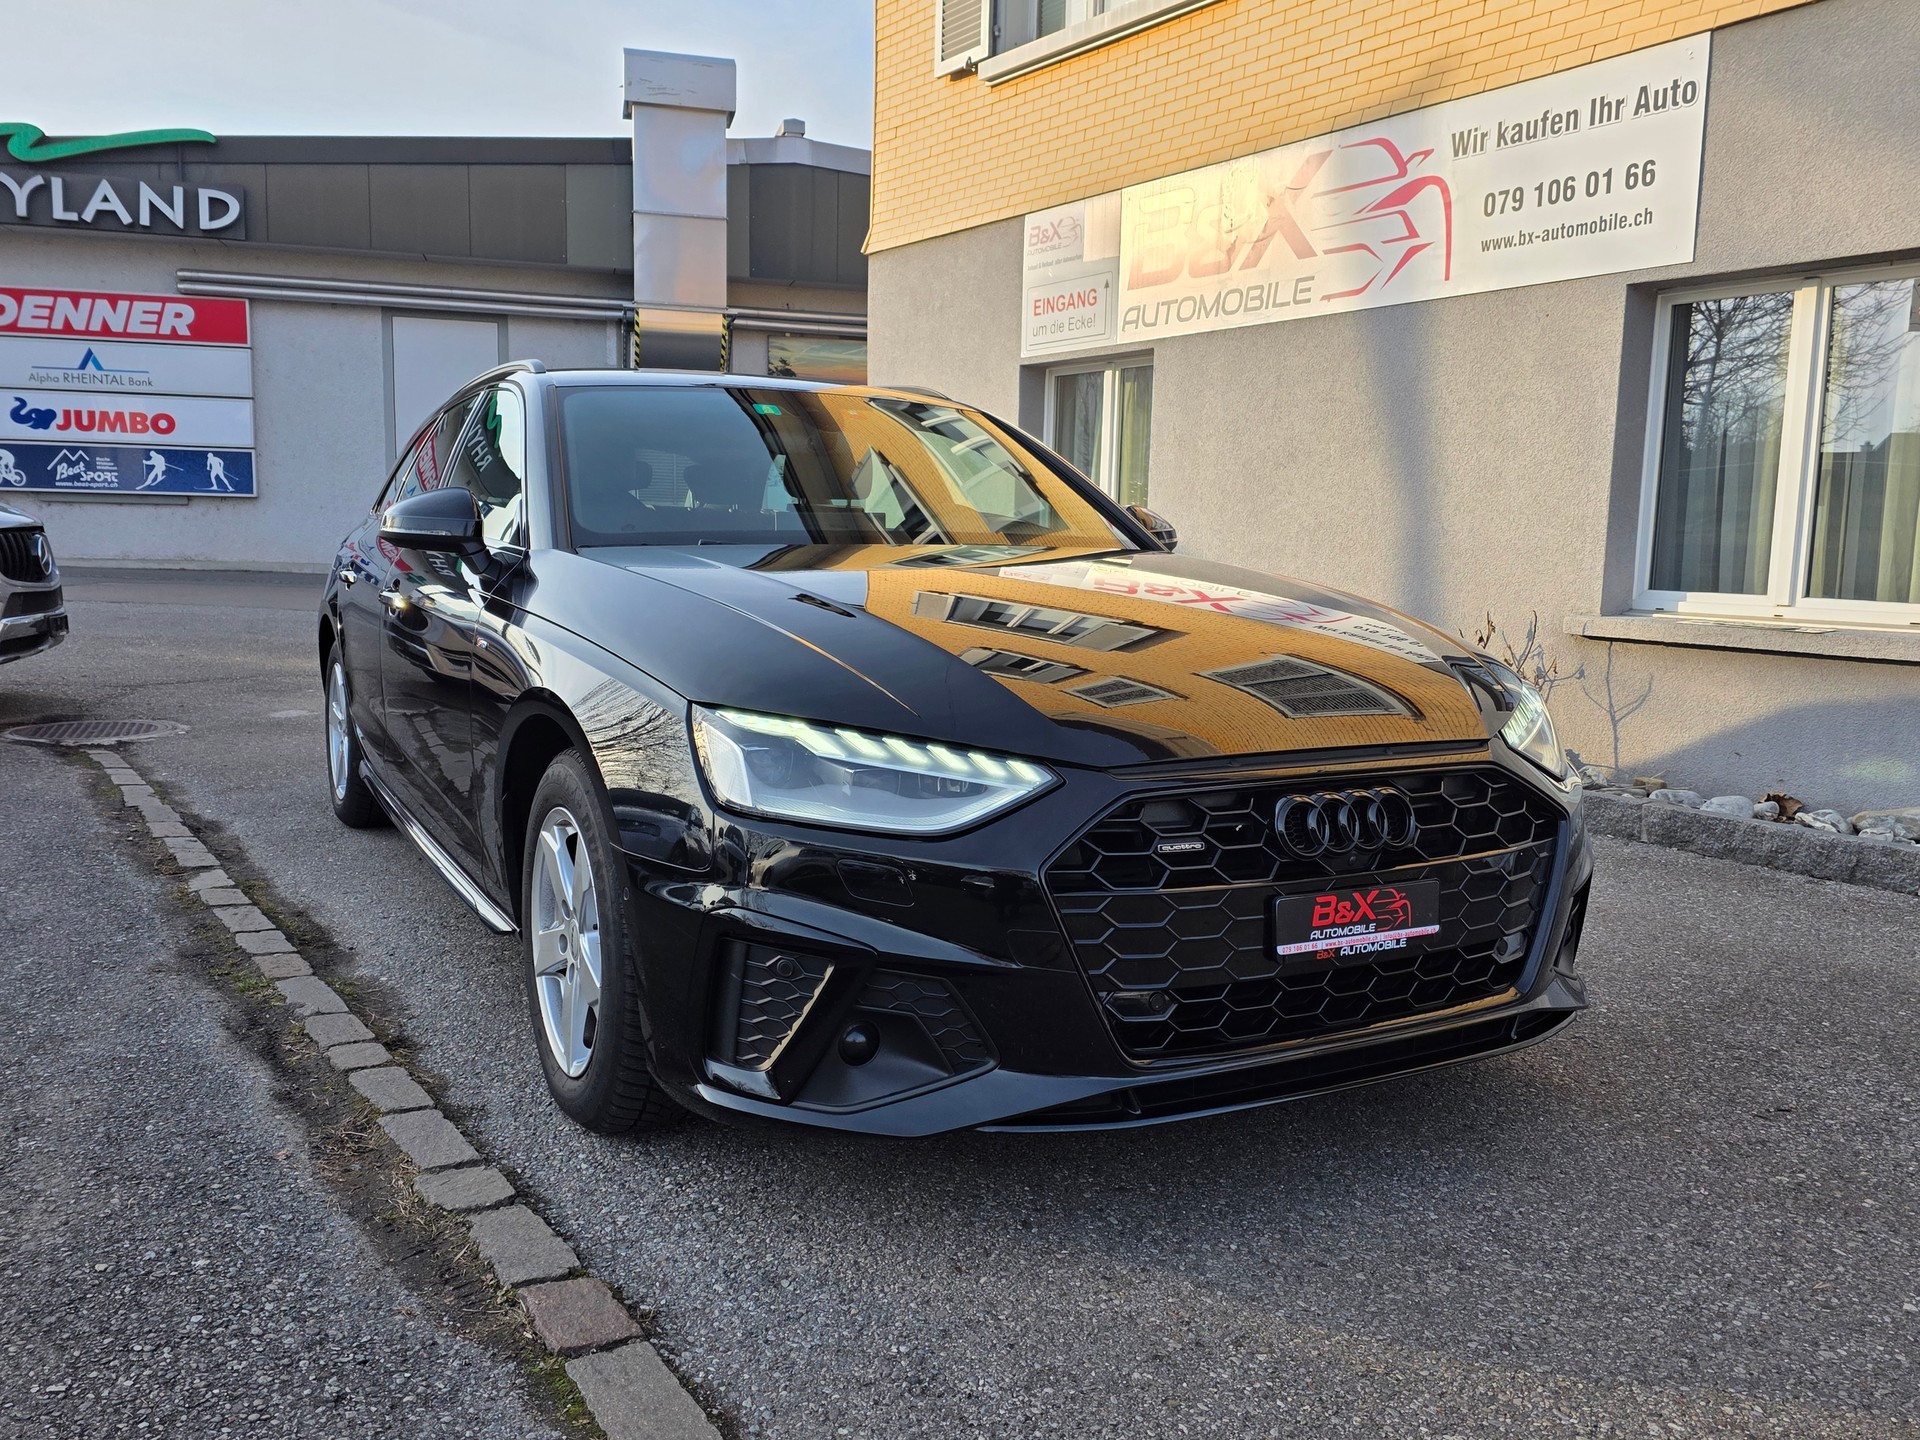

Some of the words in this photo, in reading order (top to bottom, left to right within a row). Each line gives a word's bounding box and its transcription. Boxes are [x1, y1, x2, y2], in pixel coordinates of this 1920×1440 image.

[1451, 127, 1489, 158] Wir
[1496, 109, 1579, 149] kaufen
[1589, 96, 1626, 126] Ihr
[1633, 78, 1698, 116] Auto
[0, 171, 241, 231] YLAND
[1483, 187, 1525, 217] 079
[1534, 176, 1576, 208] 106
[1584, 168, 1613, 198] 01
[1624, 159, 1657, 190] 66
[1029, 217, 1064, 247] B&X
[1481, 206, 1654, 252] www.bx-automobile.ch
[1033, 288, 1097, 316] EINGANG
[1121, 276, 1316, 331] AUTOMOBILE
[1032, 325, 1048, 337] um
[1050, 319, 1066, 333] die
[1067, 313, 1096, 332] Ecke!
[28, 372, 60, 385] Alpha
[63, 372, 125, 386] RHEINTAL
[128, 376, 153, 387] Bank
[56, 408, 176, 435] JUMBO
[55, 480, 119, 488] www.beat-sport.ch
[56, 461, 86, 480] Beat
[80, 471, 119, 482] SPORT
[1312, 889, 1380, 927] B&X
[1310, 923, 1377, 940] AUTOMOBILE
[1282, 946, 1292, 954] 079
[1310, 942, 1319, 950] 66
[1316, 949, 1336, 960] B&X
[1340, 938, 1408, 956] AUTOMOBILE
